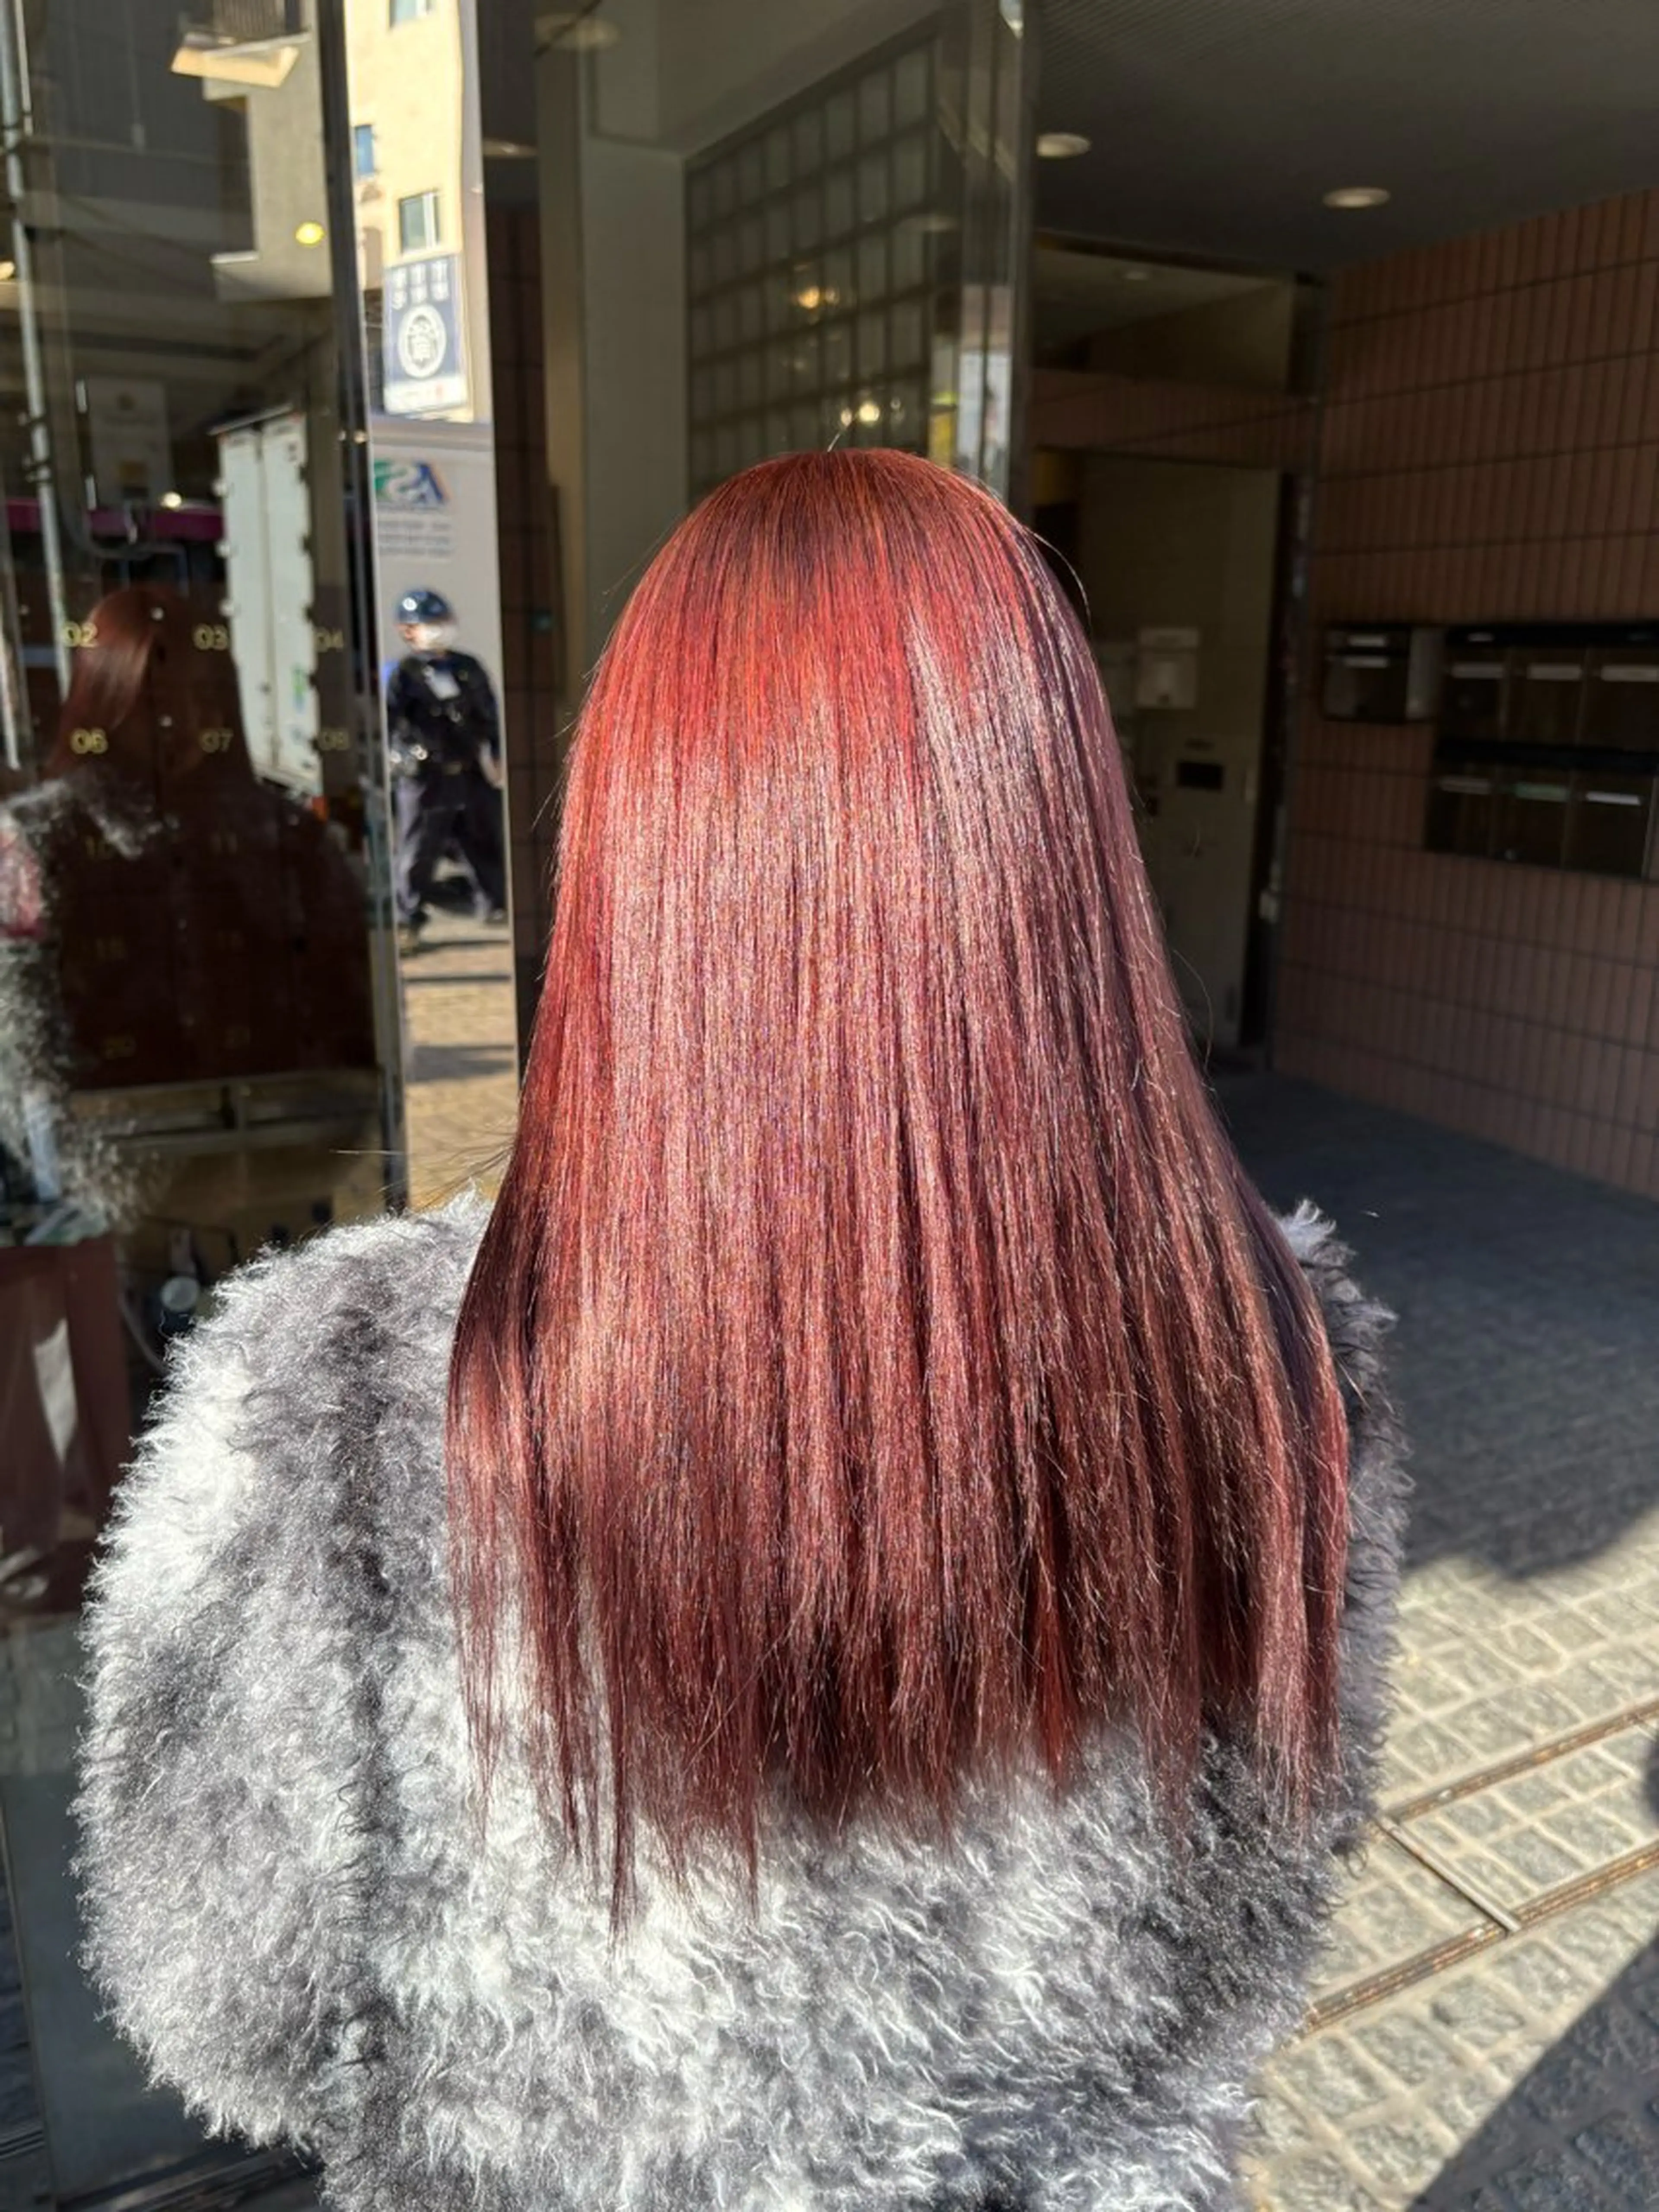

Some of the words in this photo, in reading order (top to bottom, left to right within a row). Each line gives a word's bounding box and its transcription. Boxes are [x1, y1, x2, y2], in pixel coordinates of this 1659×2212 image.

[62, 622, 98, 648] 02
[193, 623, 228, 651] 03
[70, 728, 108, 754] 06
